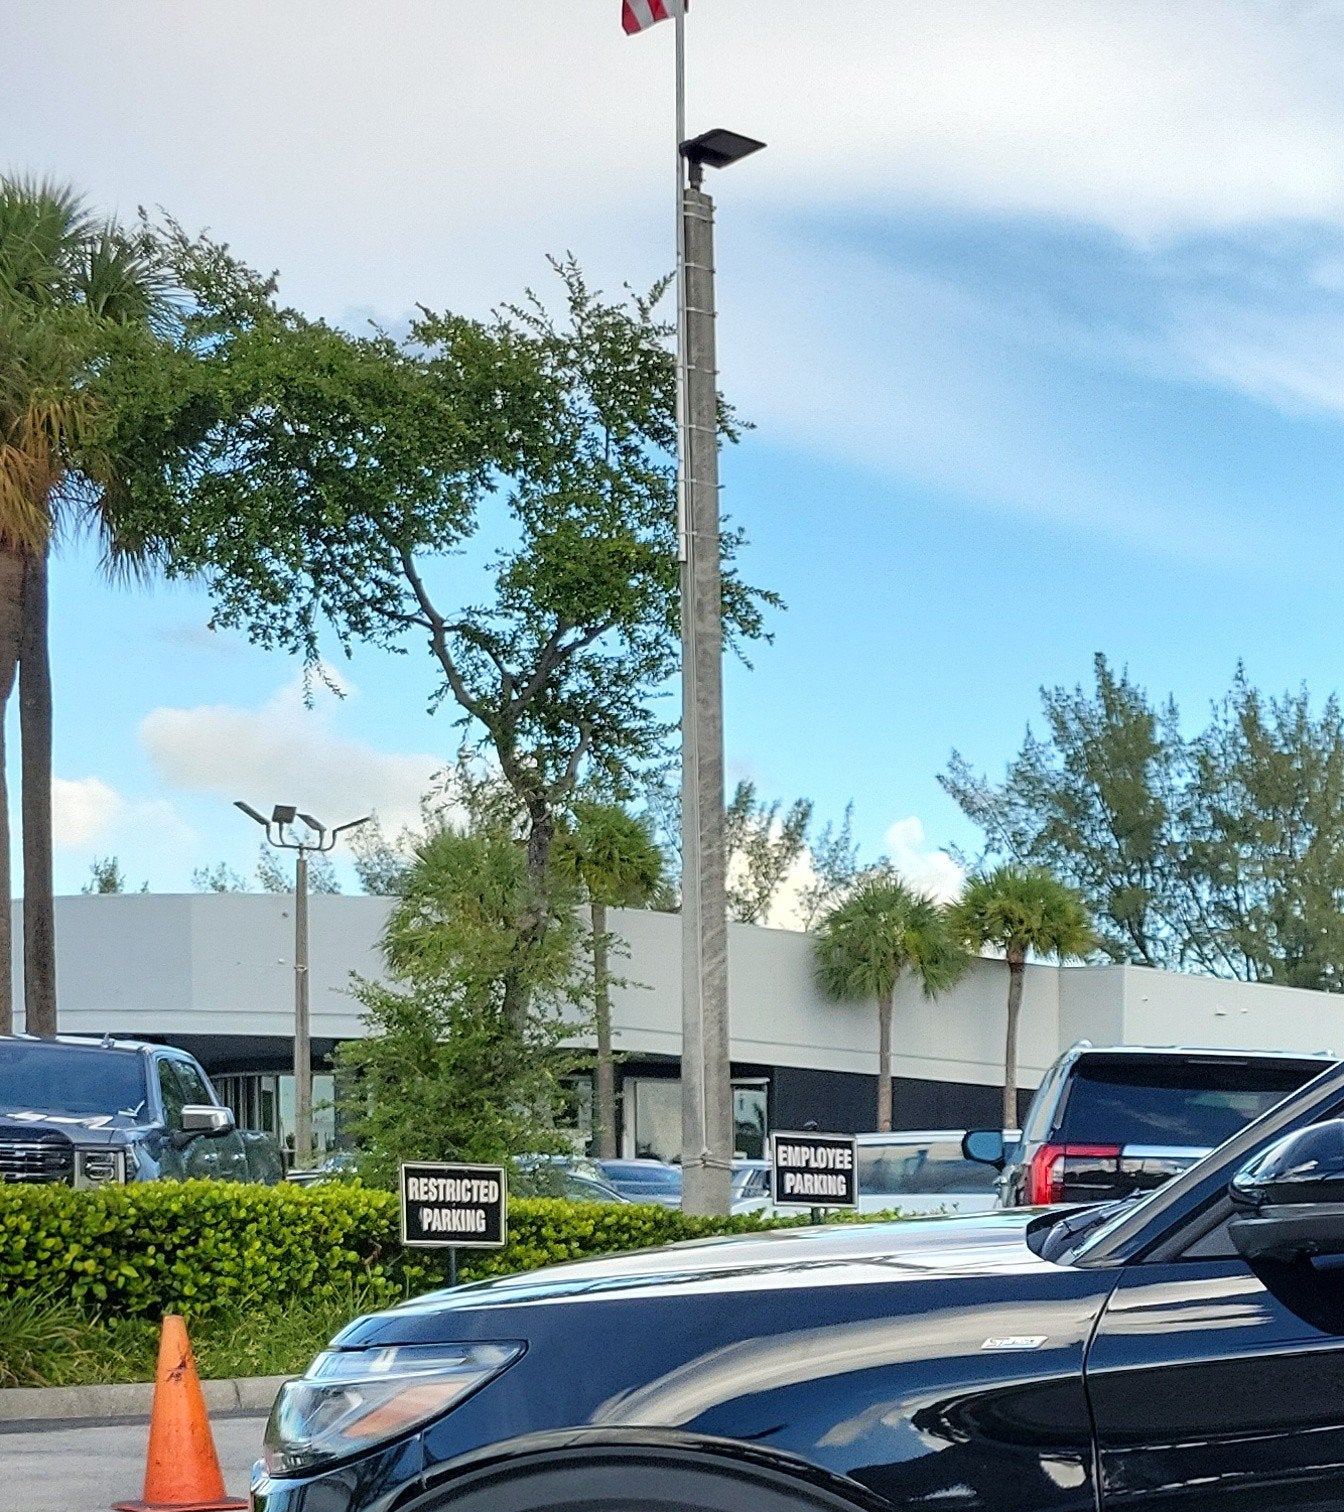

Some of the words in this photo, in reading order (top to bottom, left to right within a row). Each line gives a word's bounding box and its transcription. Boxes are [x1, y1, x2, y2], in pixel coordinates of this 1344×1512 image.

[777, 1145, 852, 1170] EMPLOYEE
[408, 1177, 499, 1203] RESTRICTED
[784, 1172, 847, 1196] PARKING
[421, 1208, 487, 1232] PARKING
